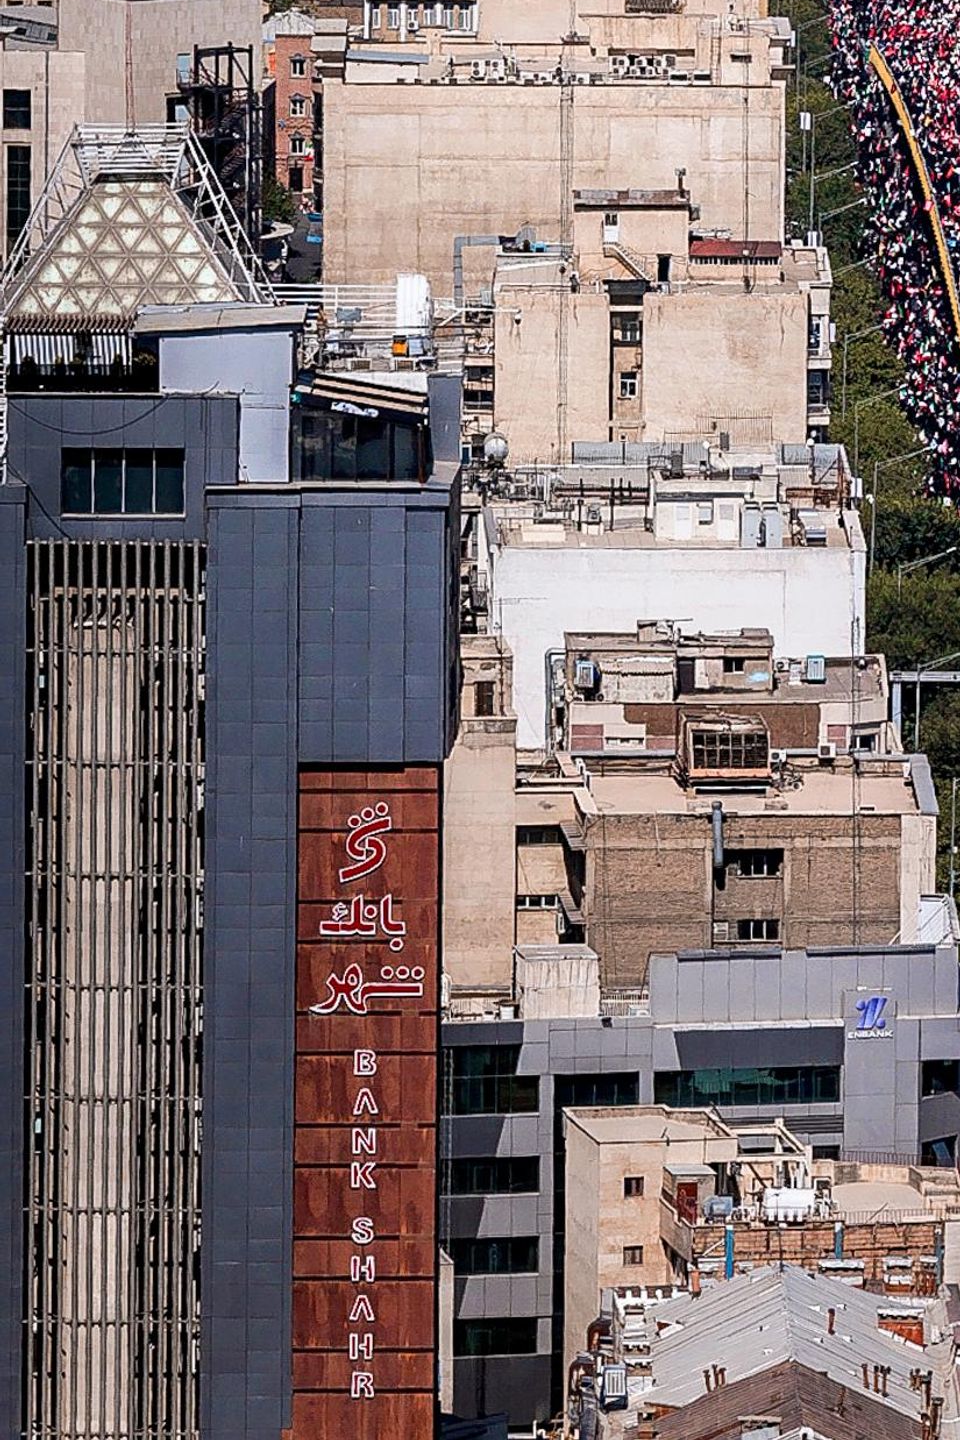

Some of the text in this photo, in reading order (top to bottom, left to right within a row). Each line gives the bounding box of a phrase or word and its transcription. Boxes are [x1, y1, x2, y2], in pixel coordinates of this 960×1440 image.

[308, 962, 425, 1015] شهر
[848, 1030, 893, 1040] ENBANK
[349, 1049, 378, 1398] BANK SHAHR
